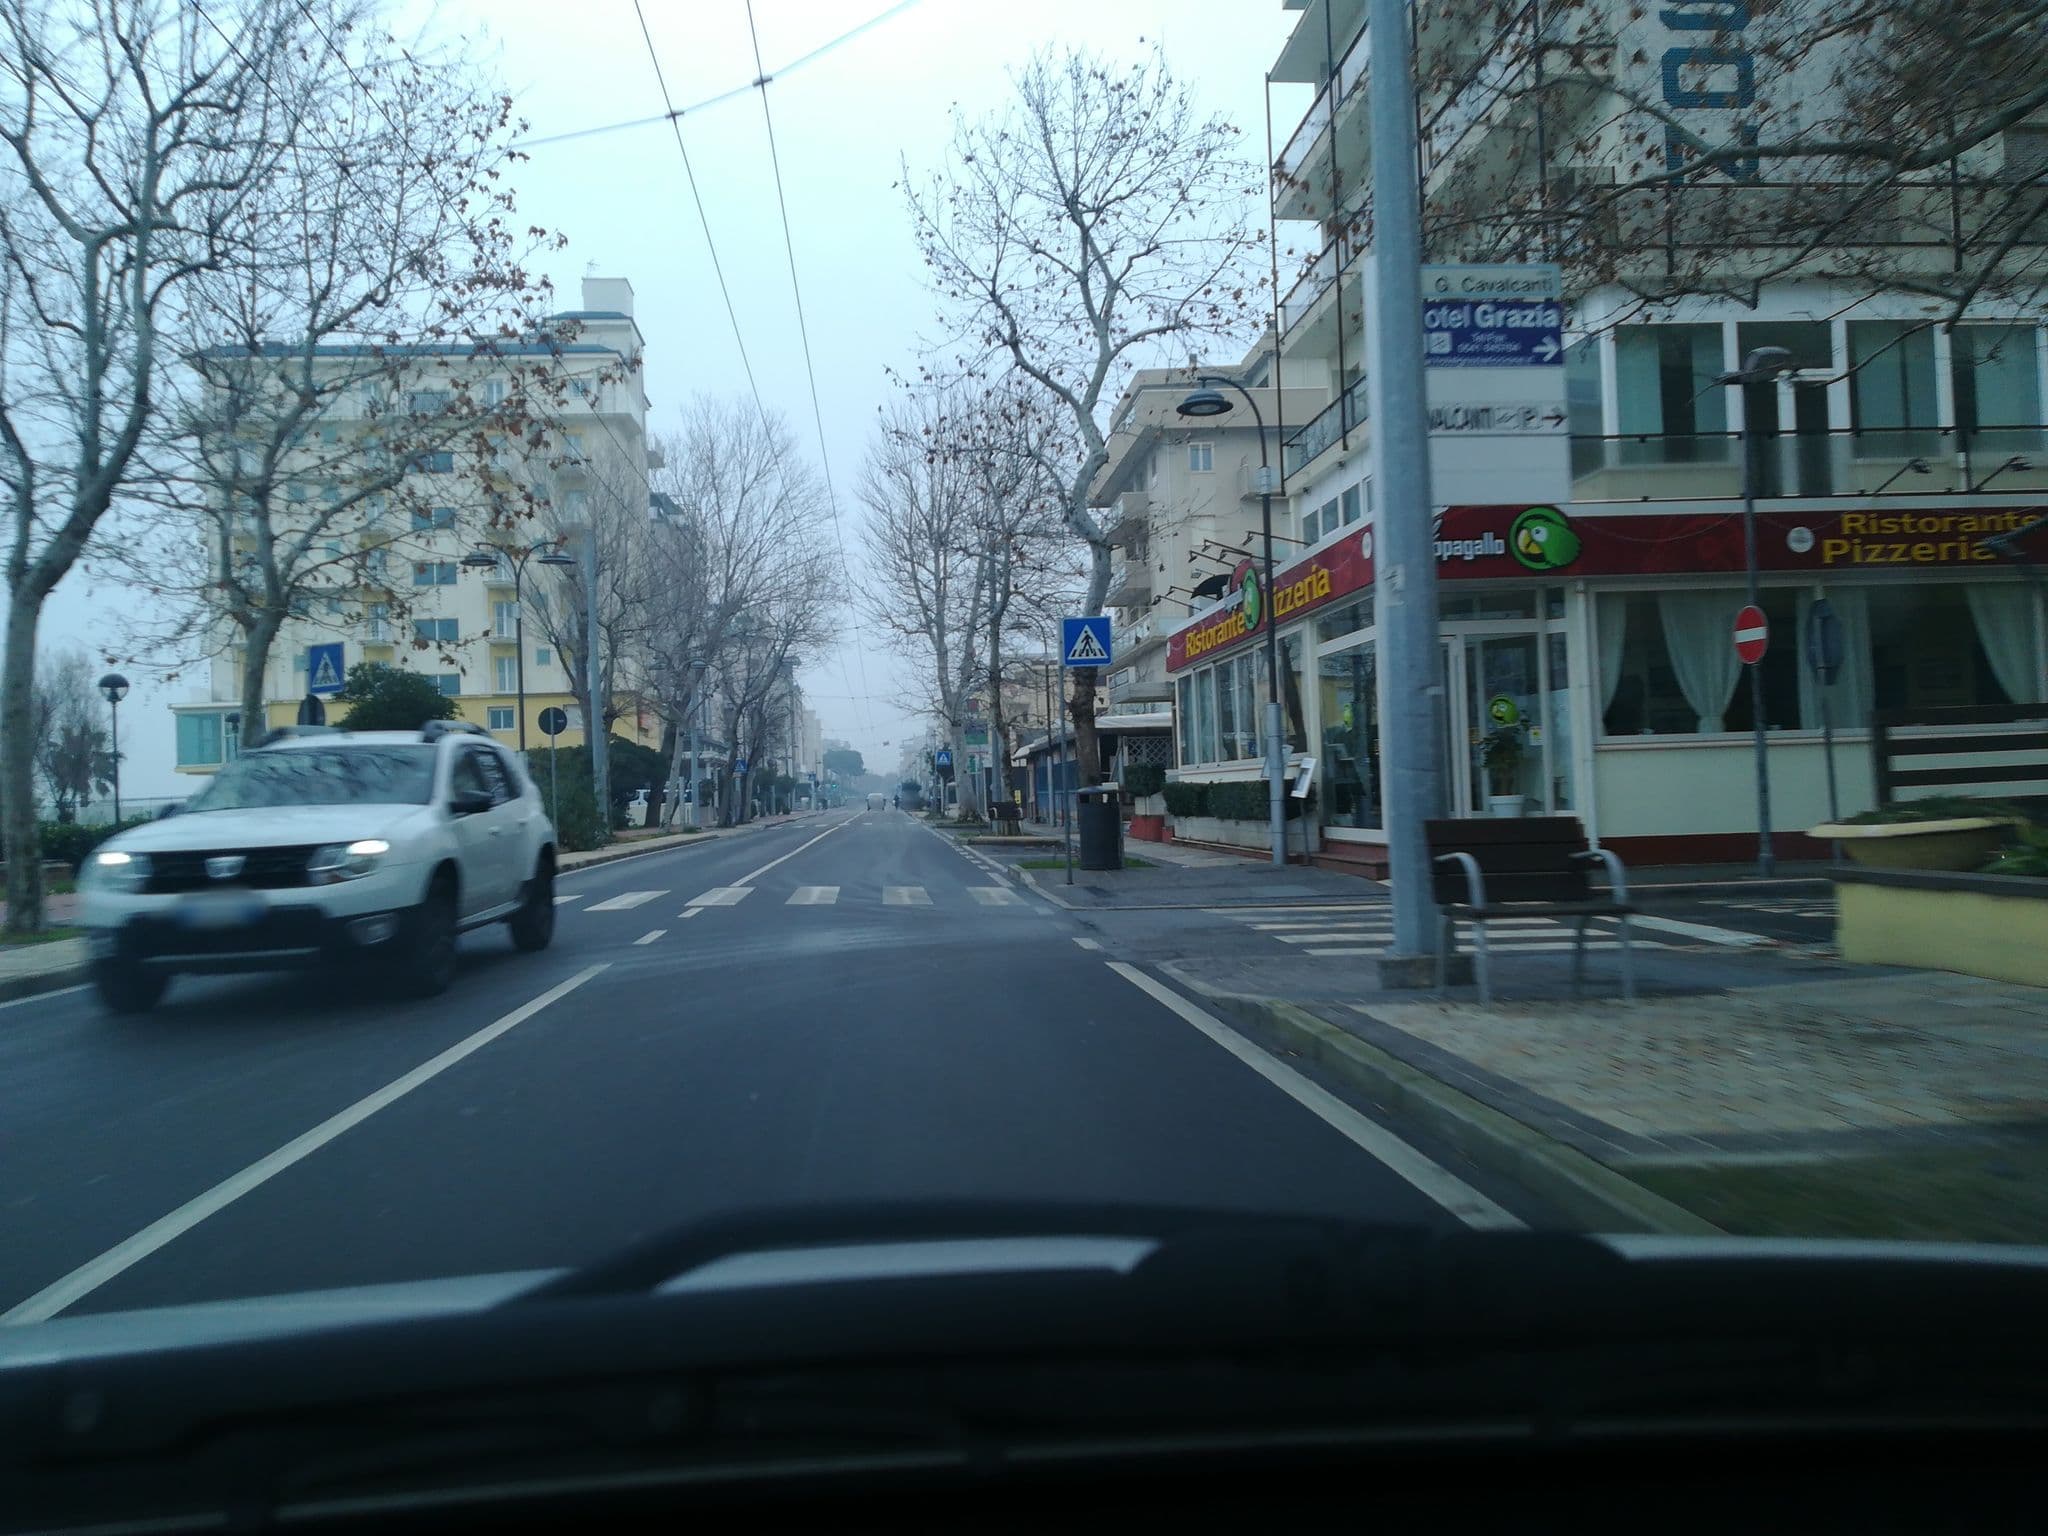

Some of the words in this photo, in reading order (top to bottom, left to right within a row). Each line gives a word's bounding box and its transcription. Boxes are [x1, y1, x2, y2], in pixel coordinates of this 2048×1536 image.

[1461, 276, 1552, 293] Cavalcanti
[1474, 303, 1559, 328] Grazia
[1841, 511, 2040, 534] Ristorante
[1822, 535, 1996, 564] Pizzeria
[1186, 612, 1245, 658] Ristorante
[1264, 564, 1331, 622] izzeria
